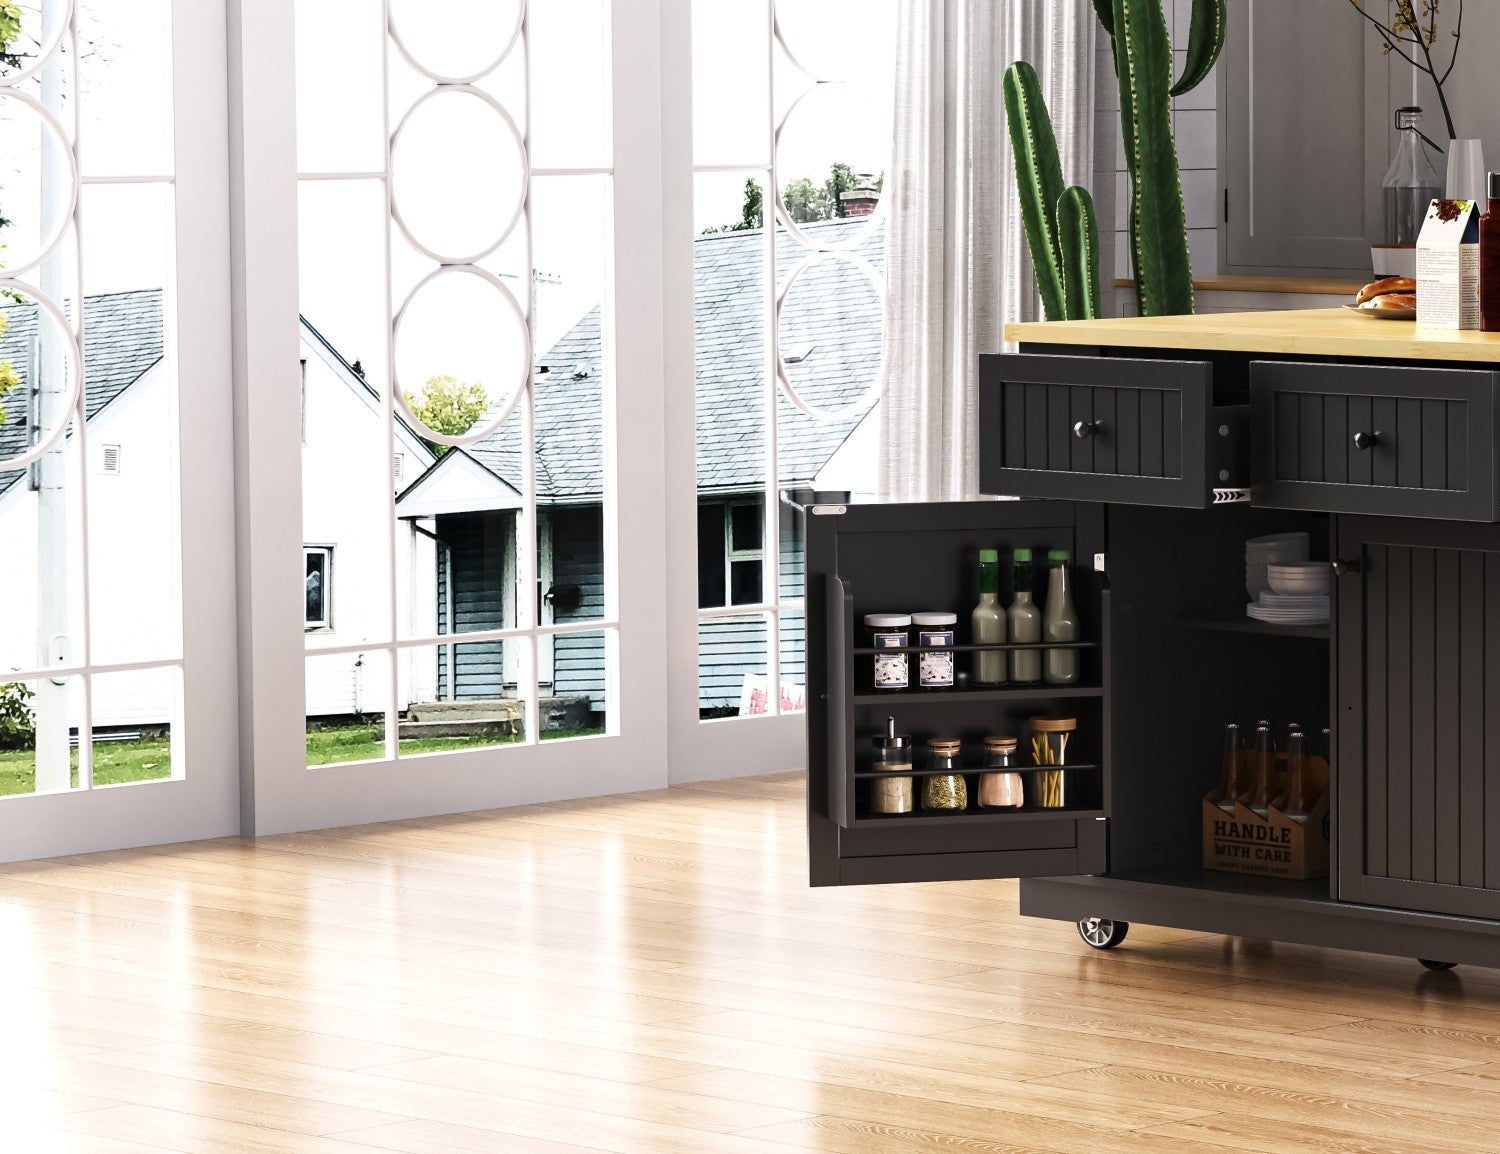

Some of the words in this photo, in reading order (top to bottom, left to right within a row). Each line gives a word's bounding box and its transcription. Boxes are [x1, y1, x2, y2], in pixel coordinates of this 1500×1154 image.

[1214, 821, 1291, 843] HANDLE
[1215, 843, 1250, 858] WITH
[1255, 848, 1291, 863] CARE
